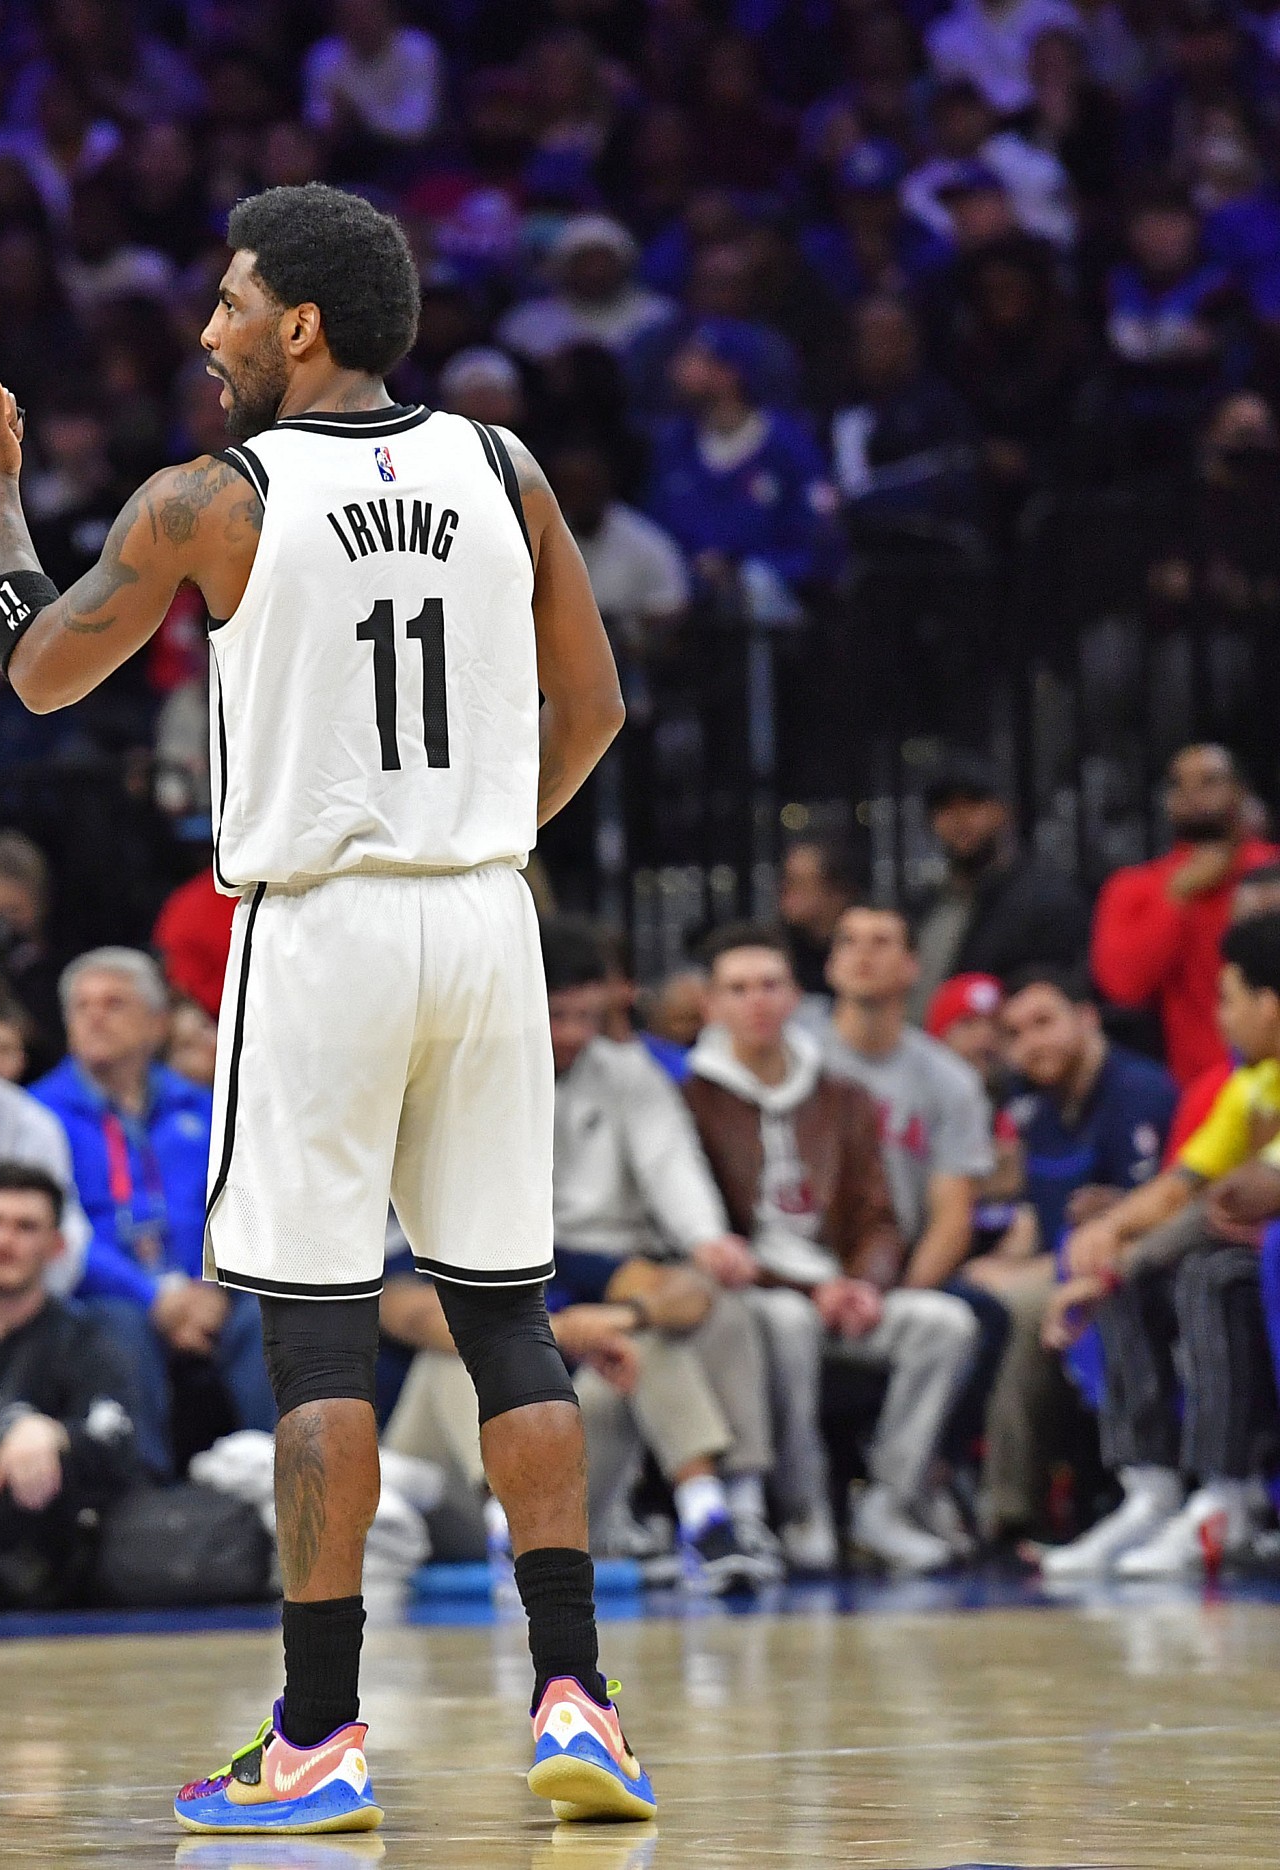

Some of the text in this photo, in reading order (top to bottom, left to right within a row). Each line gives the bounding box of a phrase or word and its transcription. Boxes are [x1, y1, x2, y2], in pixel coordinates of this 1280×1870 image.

[326, 498, 459, 563] IRVING
[6, 603, 32, 631] KAI
[356, 597, 450, 771] 11
